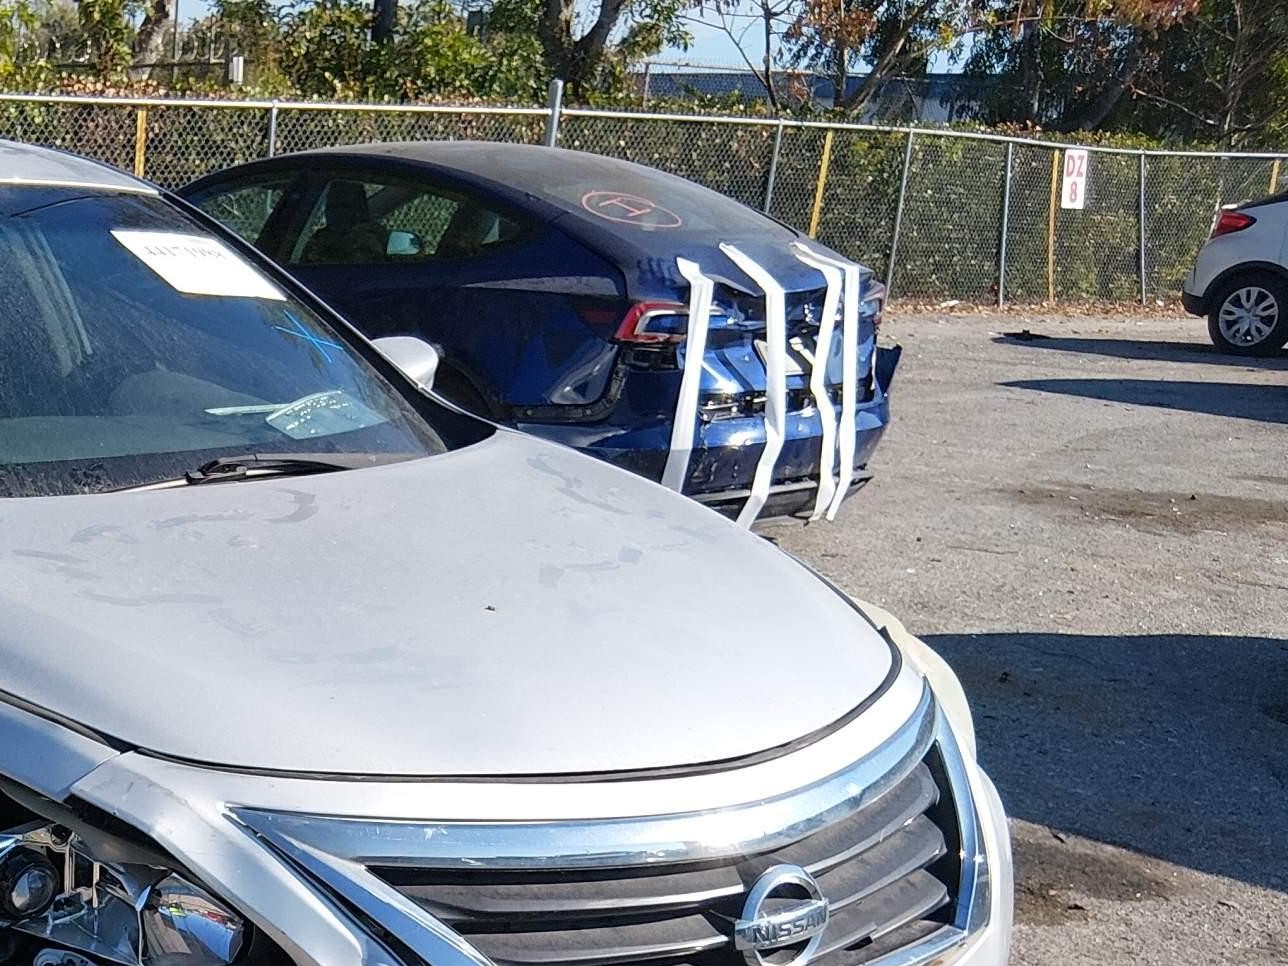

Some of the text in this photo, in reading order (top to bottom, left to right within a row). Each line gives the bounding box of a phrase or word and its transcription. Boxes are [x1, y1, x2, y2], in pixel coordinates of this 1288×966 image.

[1065, 154, 1085, 177] DZ
[1069, 181, 1078, 203] 8
[753, 907, 827, 943] NISSAN
